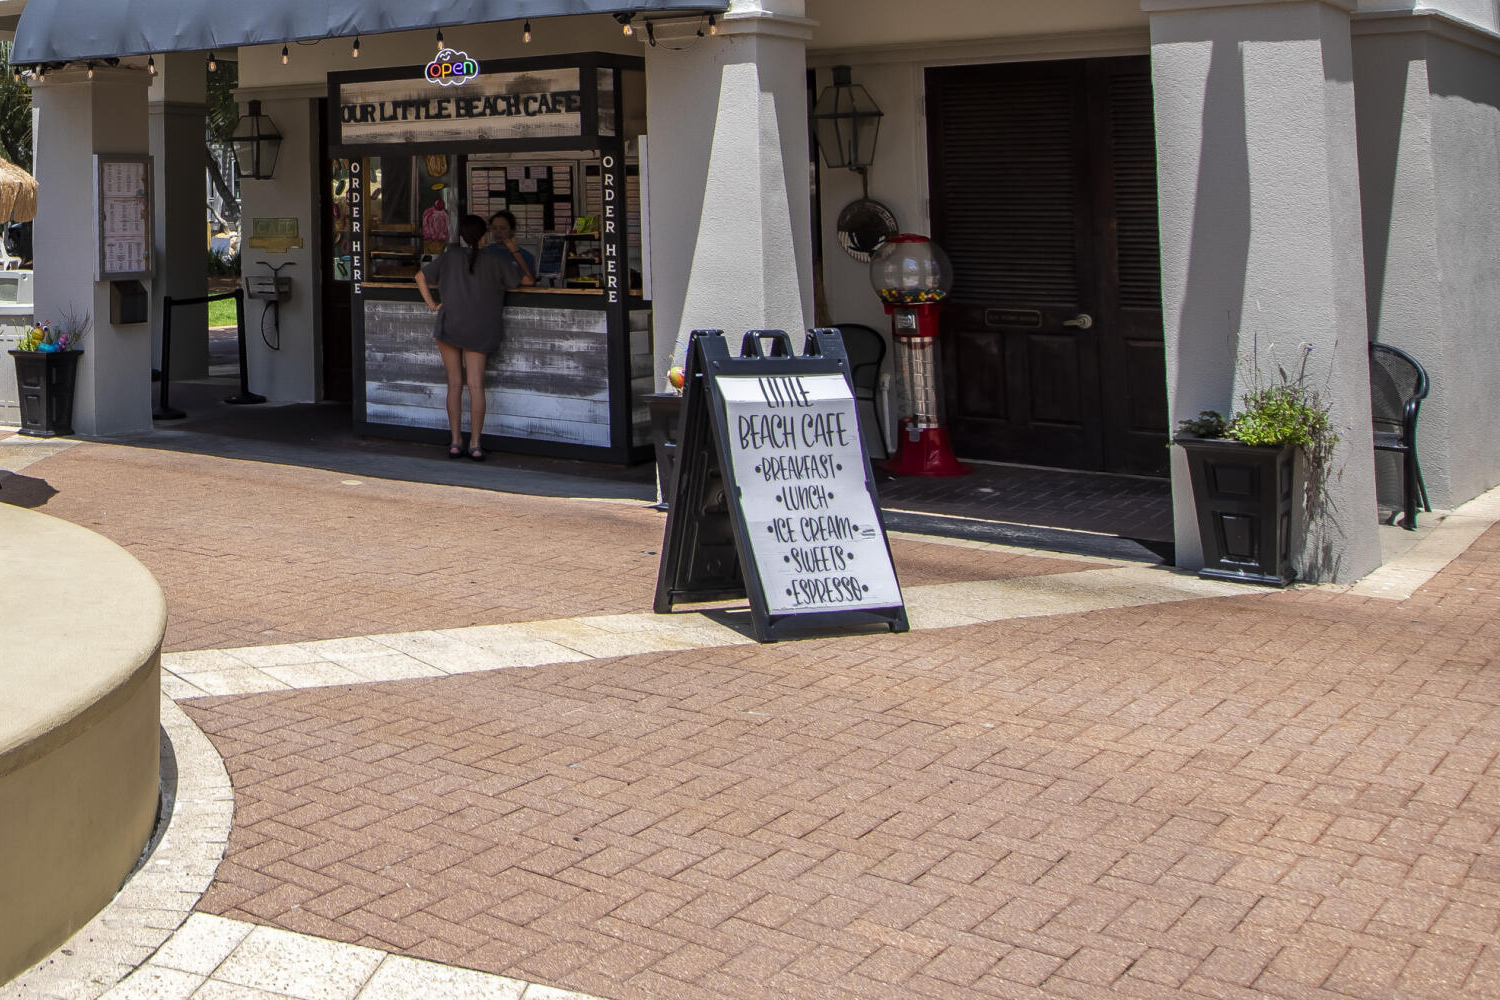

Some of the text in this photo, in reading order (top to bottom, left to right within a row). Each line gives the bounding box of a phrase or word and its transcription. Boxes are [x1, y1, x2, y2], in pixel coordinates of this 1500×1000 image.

[430, 61, 473, 78] open
[341, 90, 580, 123] OUR LITTLE BEACH CAFE
[351, 162, 361, 294] ORDER HERE
[603, 156, 617, 303] ORDER HERE
[758, 376, 814, 408] LITTLE
[738, 412, 850, 450] BEACH CAFE
[762, 454, 836, 482] BREAKFAST
[773, 515, 854, 543] ICE CREAM
[790, 545, 846, 573] SWEETS
[791, 577, 863, 606] ESPRESSO
